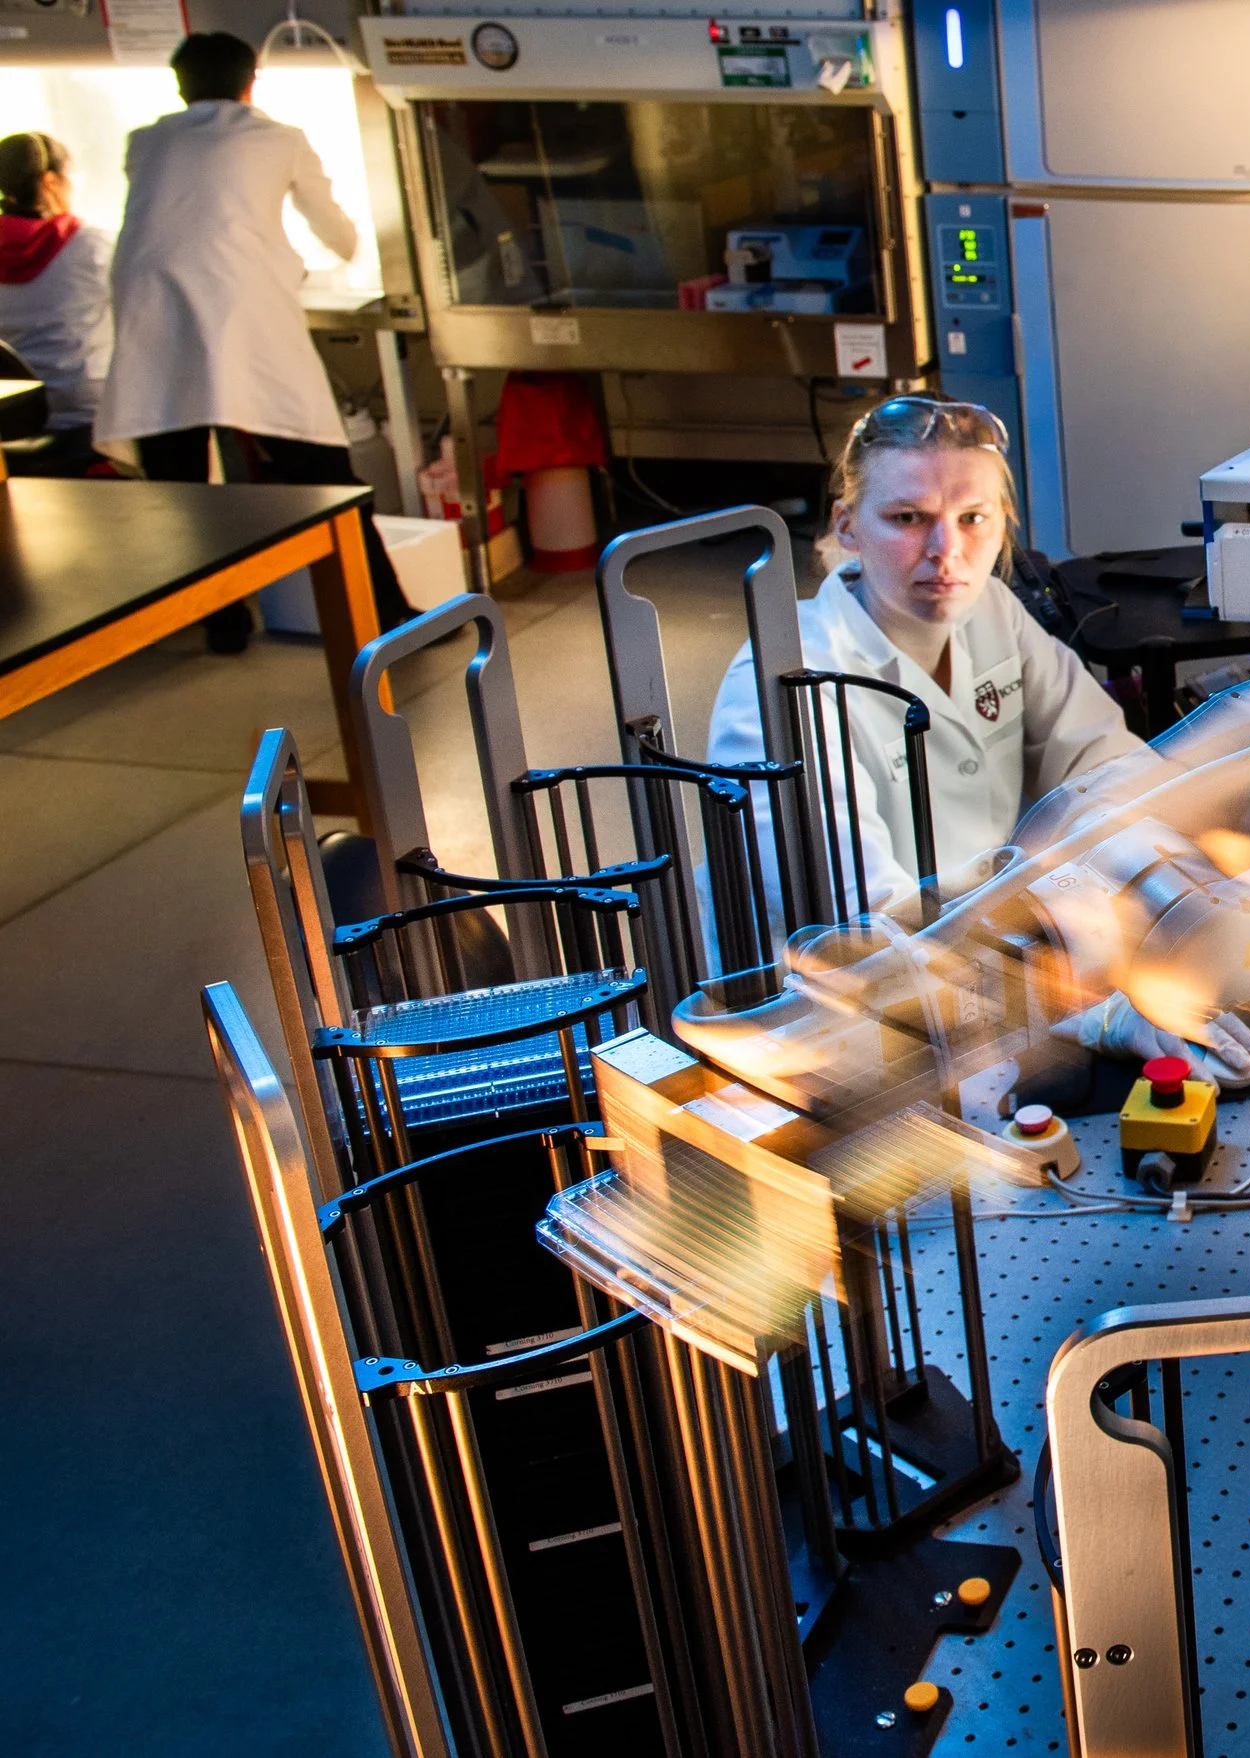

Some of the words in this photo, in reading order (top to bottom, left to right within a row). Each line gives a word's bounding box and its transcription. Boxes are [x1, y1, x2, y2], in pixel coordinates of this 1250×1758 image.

[1049, 873, 1077, 888] J6
[505, 1336, 536, 1348] Corning
[514, 1382, 545, 1393] Corning
